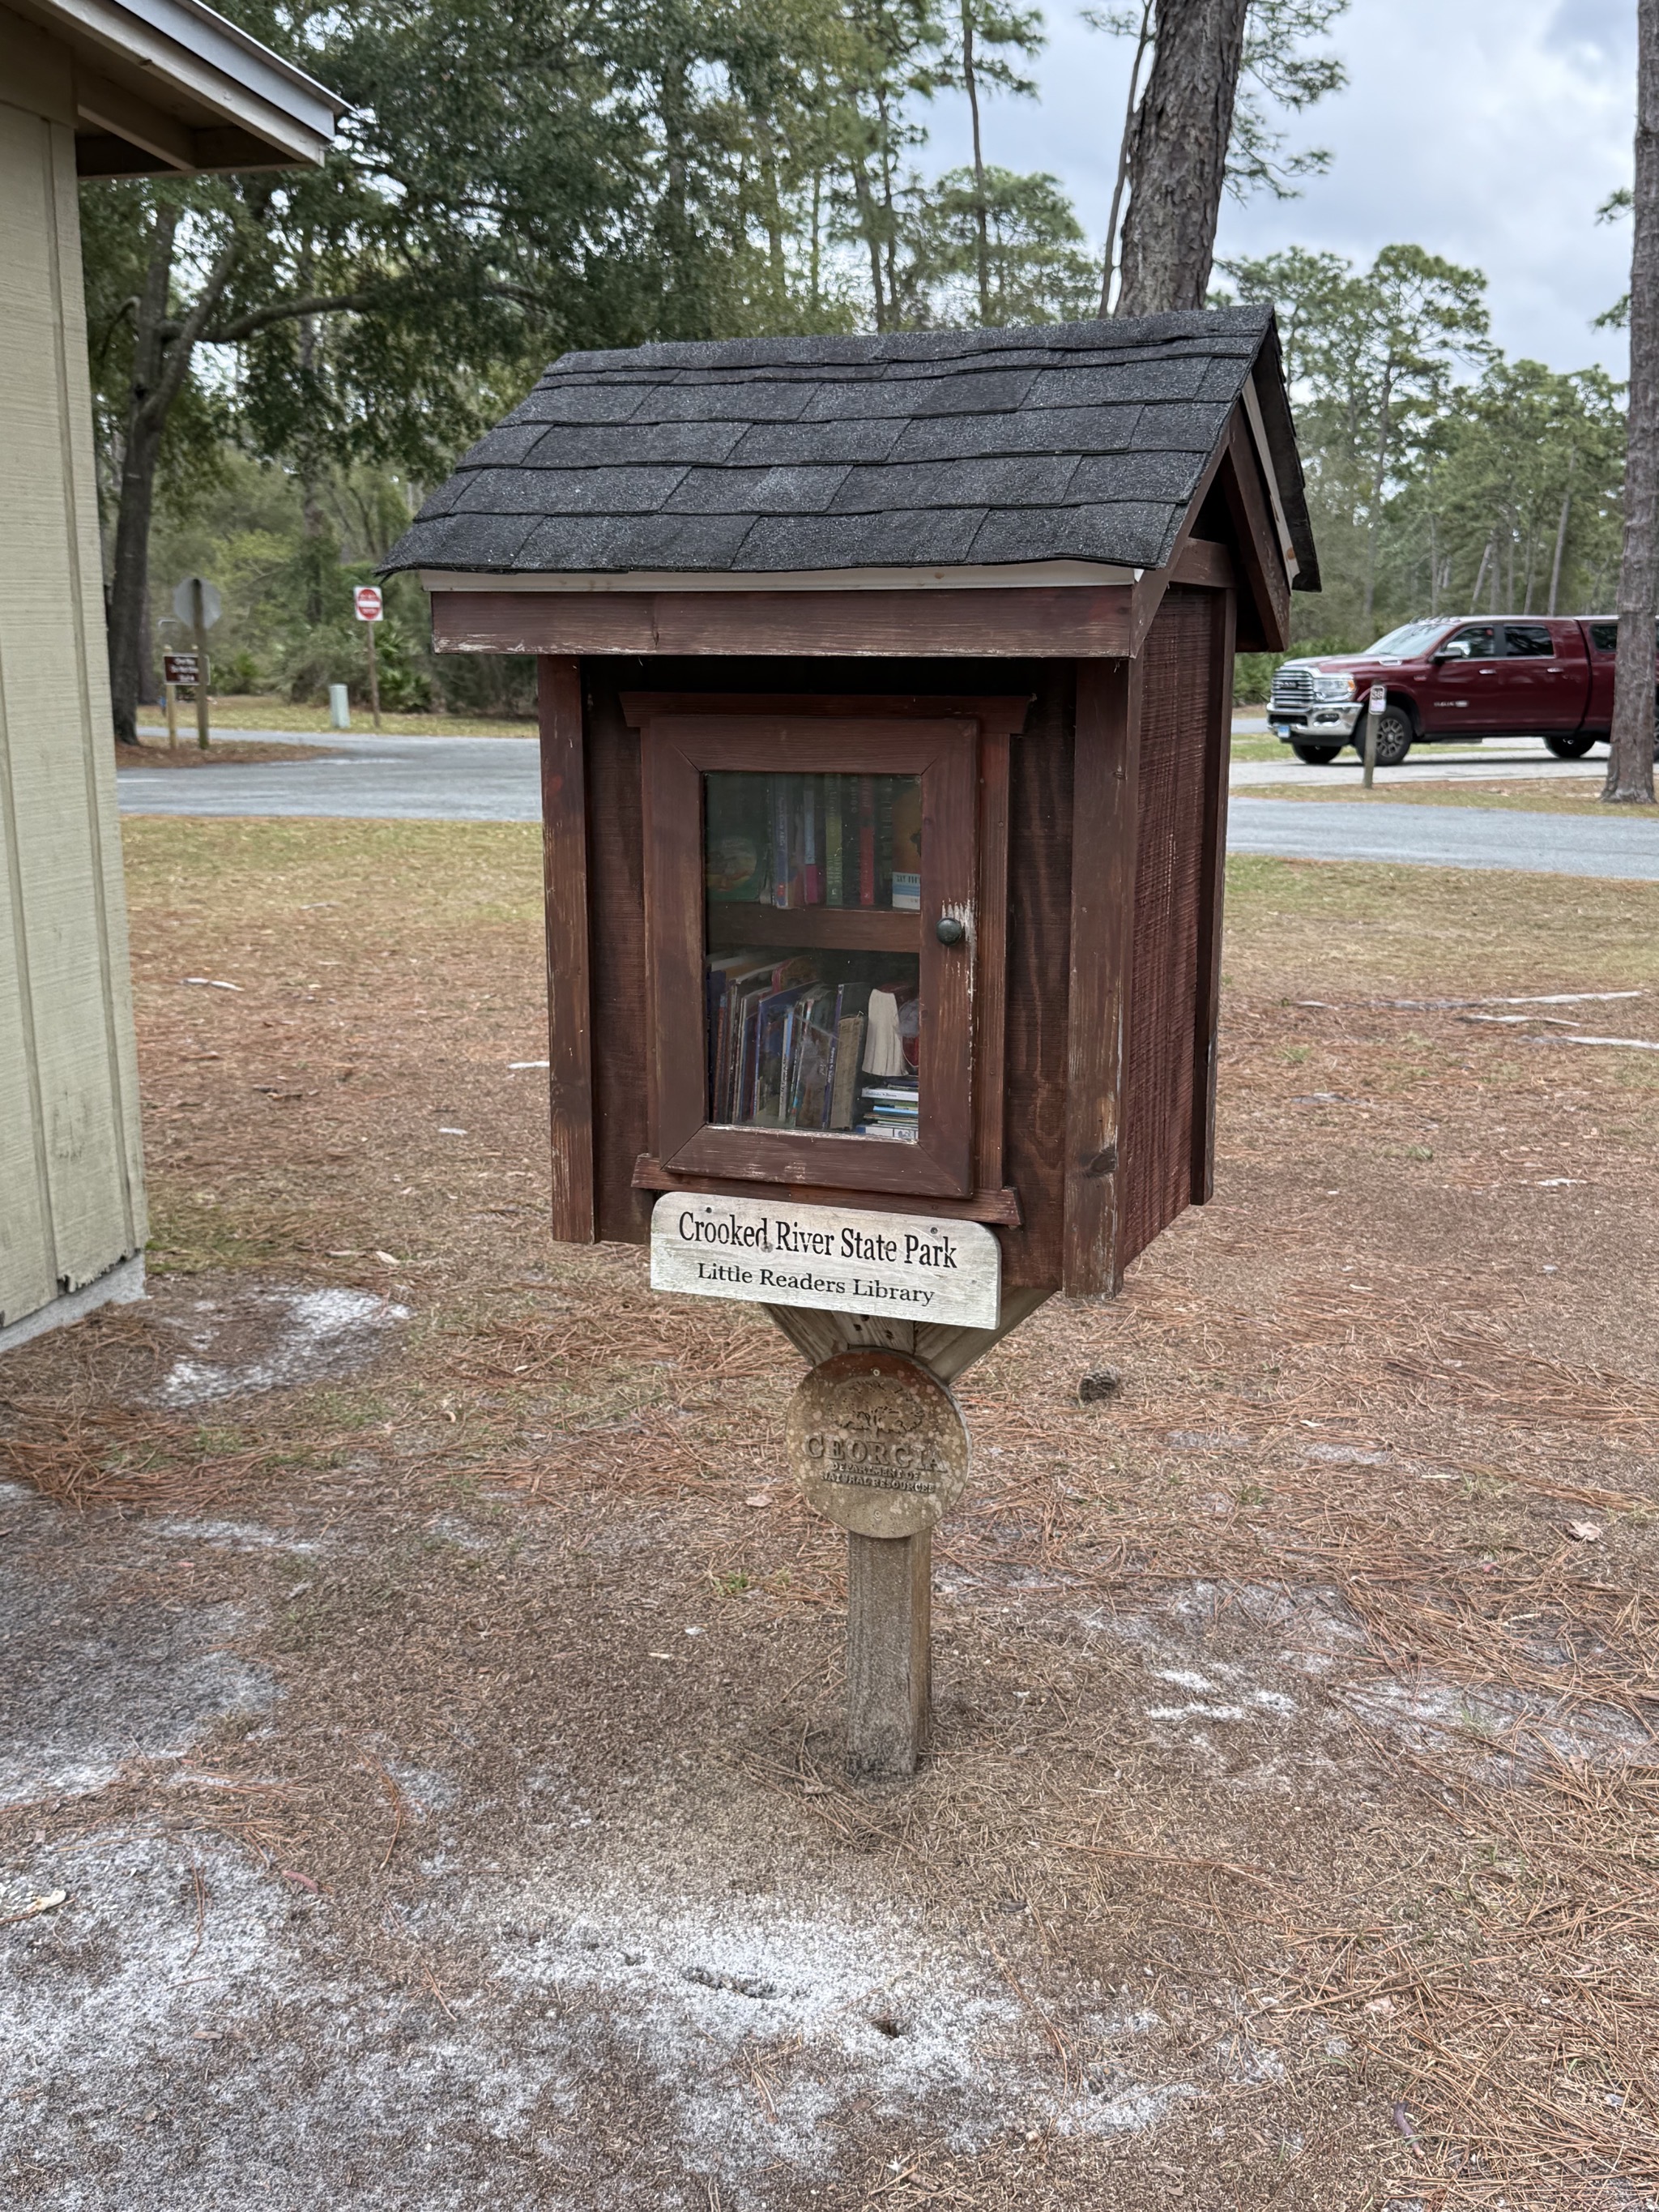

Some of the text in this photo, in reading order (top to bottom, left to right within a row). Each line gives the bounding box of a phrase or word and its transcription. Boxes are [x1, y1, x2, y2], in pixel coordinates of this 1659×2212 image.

[679, 1211, 958, 1268] Crooked River State Park
[697, 1262, 936, 1307] Little Readers Library
[804, 1433, 948, 1473] GEORGIA
[831, 1461, 903, 1479] DEPARTMENT
[819, 1469, 936, 1494] NATURAL RESOURCES
